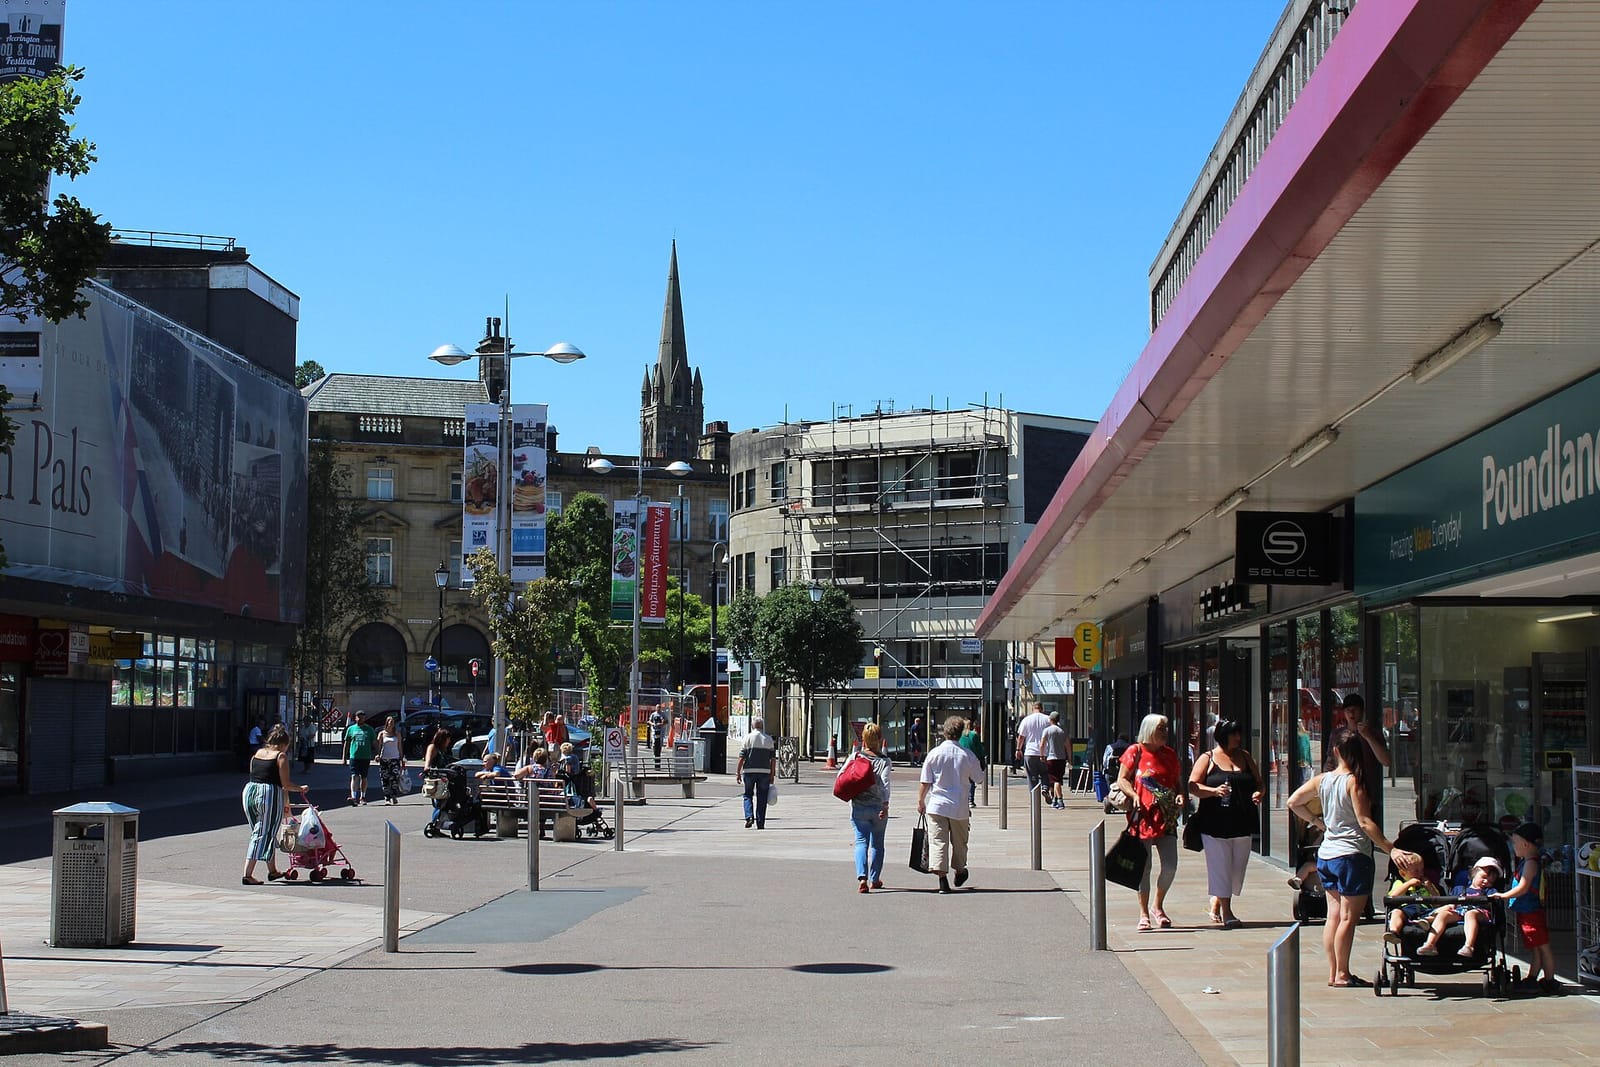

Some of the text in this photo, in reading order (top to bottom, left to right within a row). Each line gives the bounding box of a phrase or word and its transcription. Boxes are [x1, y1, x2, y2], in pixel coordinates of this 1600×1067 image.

[17, 43, 23, 57] &
[28, 43, 57, 59] DRINK
[6, 56, 37, 66] Festival
[29, 419, 92, 517] Pals
[648, 508, 665, 617] #AmazingAccrington
[73, 842, 96, 851] Litter
